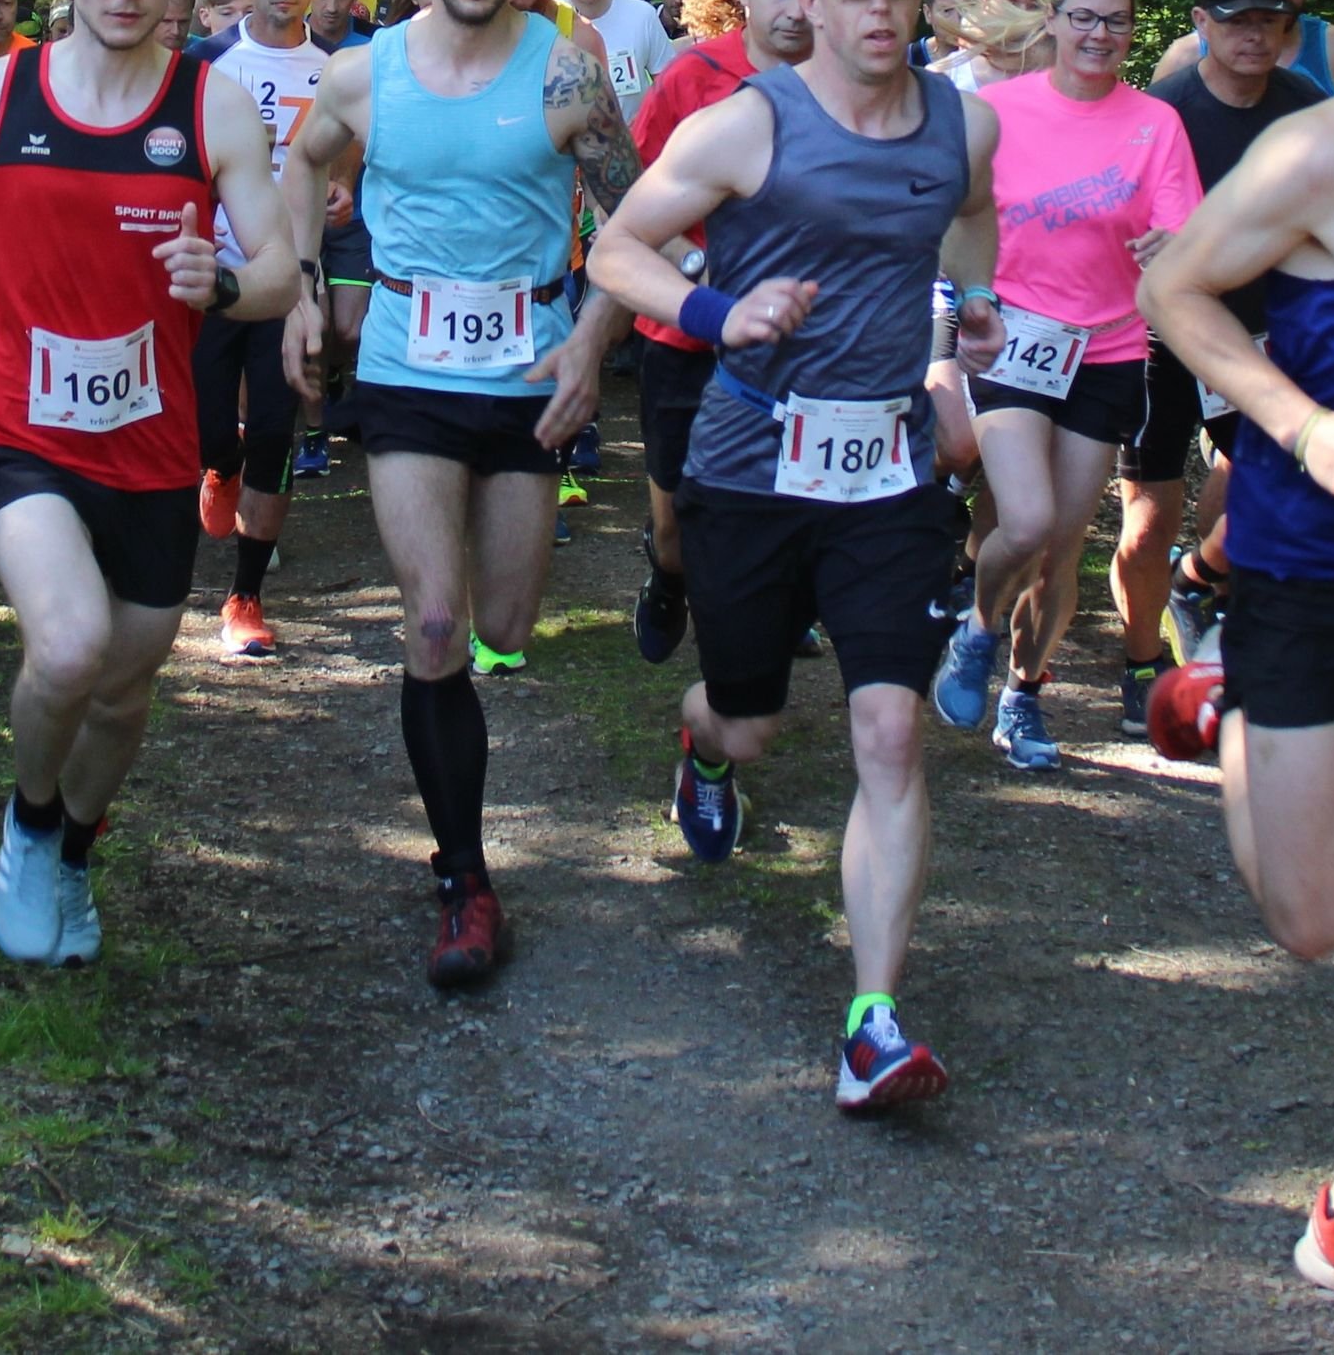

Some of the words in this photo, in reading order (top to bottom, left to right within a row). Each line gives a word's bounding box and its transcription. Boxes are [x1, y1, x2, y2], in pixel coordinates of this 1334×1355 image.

[21, 145, 51, 155] erima
[149, 138, 183, 148] SPORT
[151, 147, 180, 156] 2000
[114, 205, 156, 220] SPORT
[1042, 176, 1142, 233] KATHRIN
[442, 311, 505, 344] 193
[1007, 336, 1058, 373] 142
[63, 368, 131, 407] 160
[817, 437, 885, 474] 180
